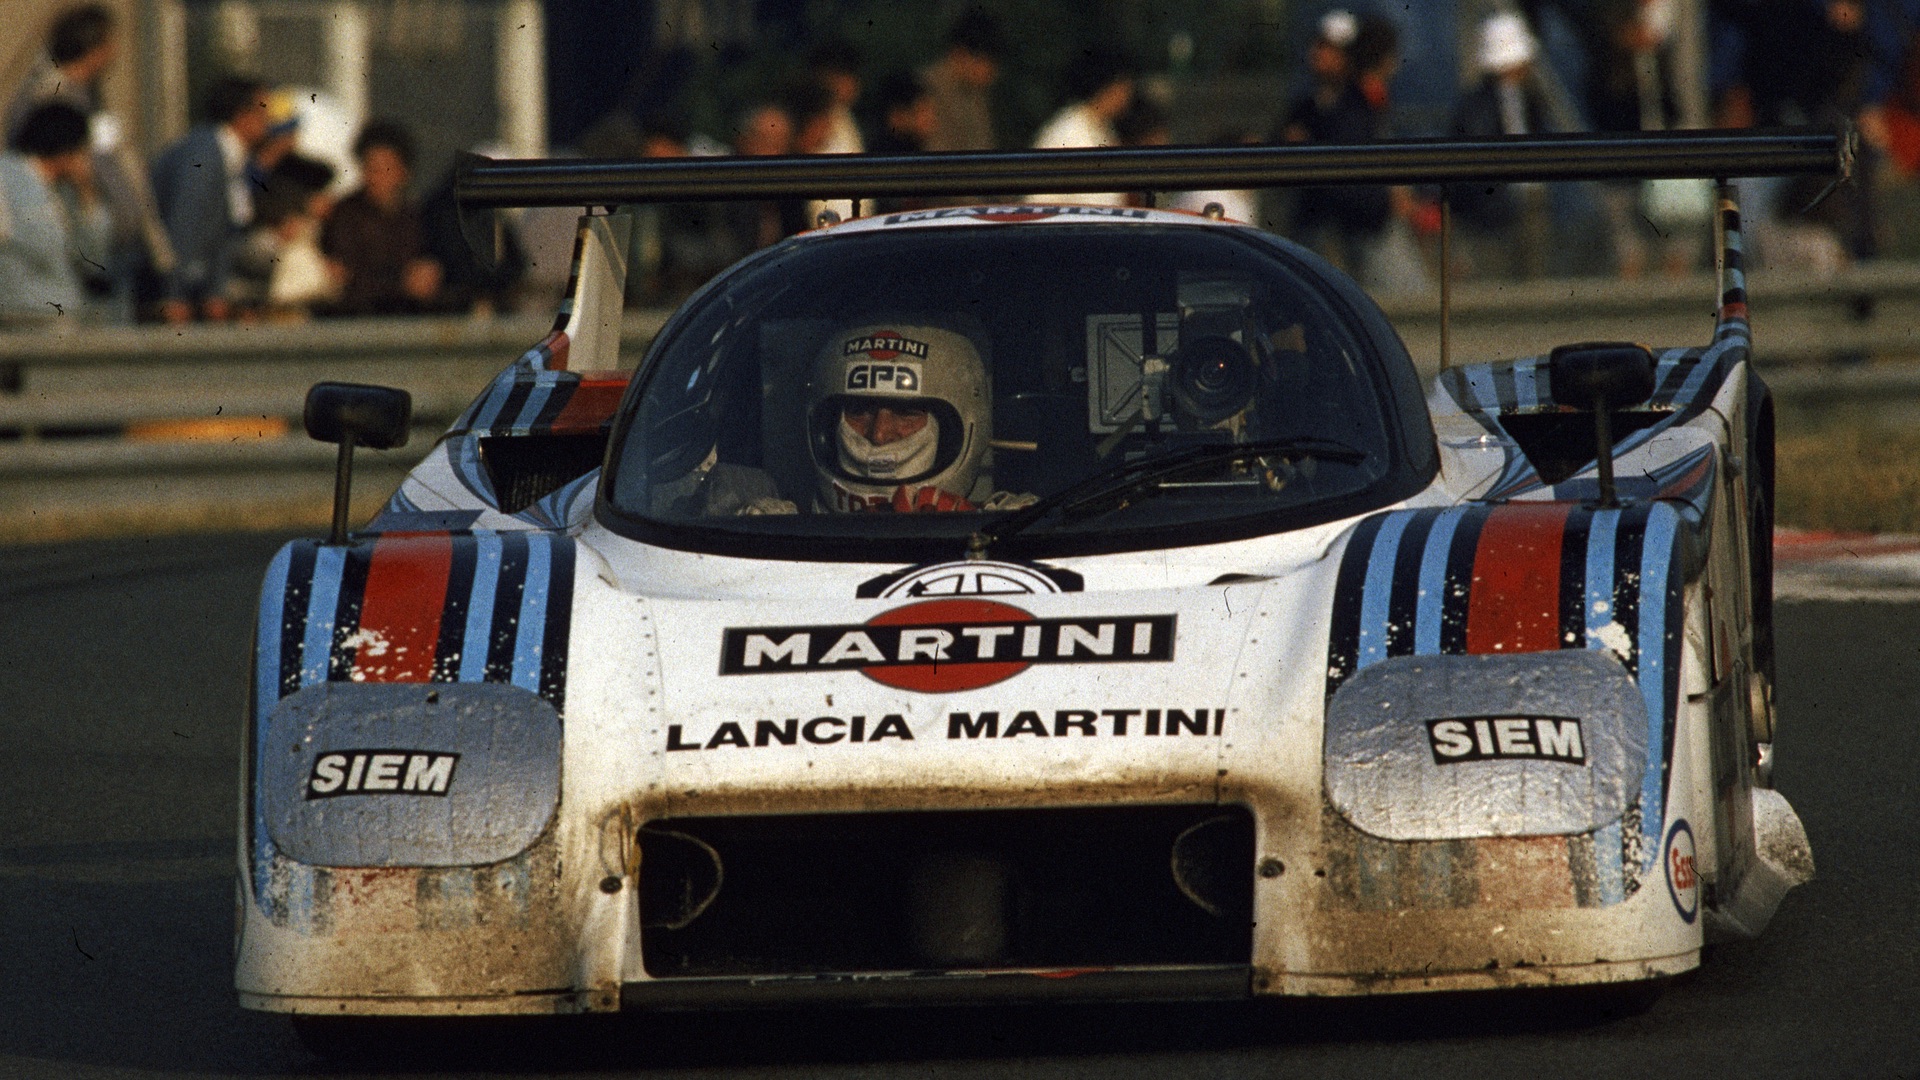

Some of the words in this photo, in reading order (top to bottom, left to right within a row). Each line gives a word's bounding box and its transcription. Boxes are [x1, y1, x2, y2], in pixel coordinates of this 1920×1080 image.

[847, 338, 925, 356] MARTINI
[847, 365, 919, 390] GPA
[743, 622, 1153, 667] MARTINI
[666, 714, 914, 752] LANCIA
[947, 708, 1226, 739] MARTINI
[1432, 719, 1584, 758] SIEM
[311, 754, 455, 793] SIEM
[1672, 847, 1696, 890] Ess
